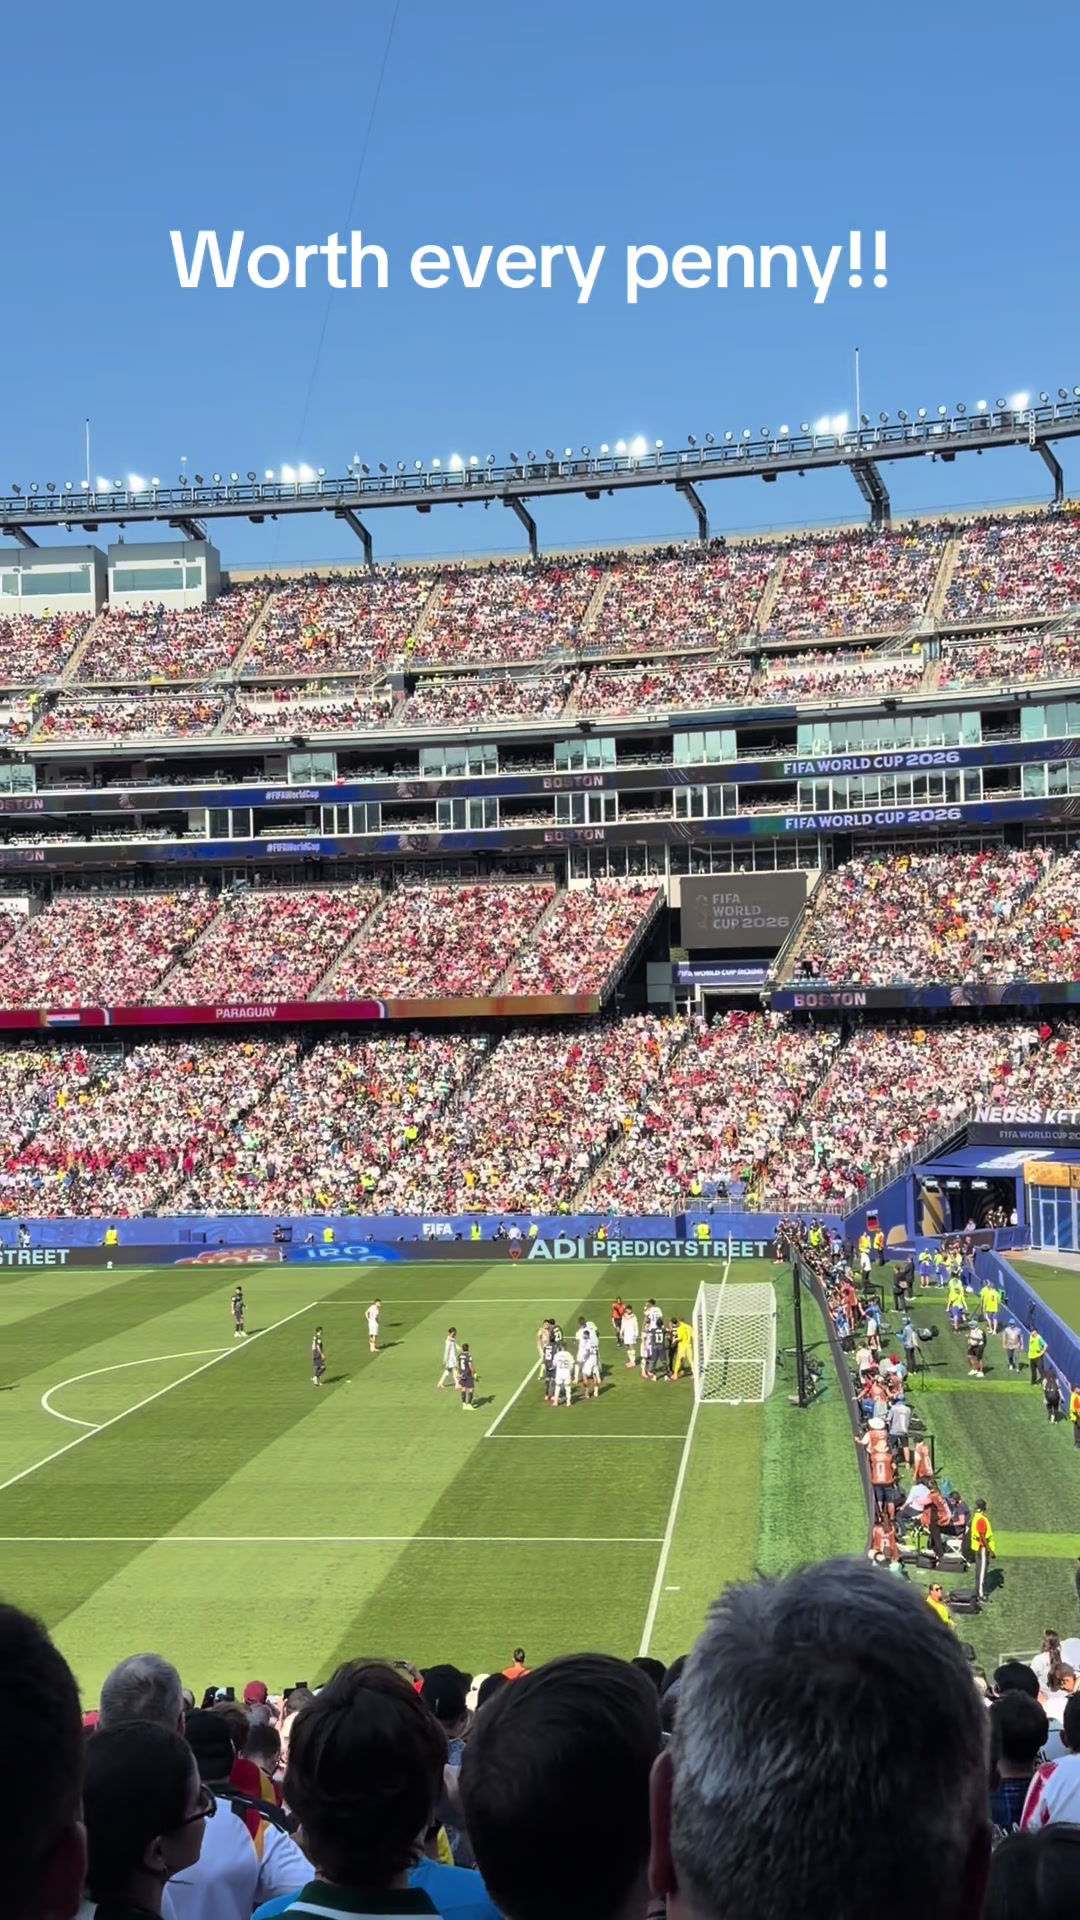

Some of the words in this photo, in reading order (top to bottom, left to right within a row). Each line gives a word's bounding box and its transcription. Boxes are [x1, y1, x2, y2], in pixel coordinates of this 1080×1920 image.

[783, 762, 816, 775] FIFA
[816, 756, 871, 772] WORLD
[873, 754, 904, 769] CUP
[906, 751, 960, 766] 2026
[543, 774, 604, 789] BOSTON
[265, 788, 320, 800] #FIFAWorldCup
[785, 818, 817, 830] FIFA
[818, 812, 872, 828] WORLD
[874, 810, 905, 824] CUP
[907, 808, 962, 822] 2026
[712, 894, 741, 904] FIFA
[712, 905, 762, 917] WORLD
[713, 918, 740, 929] CUP
[742, 917, 790, 928] 2026
[694, 969, 720, 977] WORLD
[721, 968, 737, 976] CUP
[793, 992, 867, 1007] BOSTON
[215, 1006, 278, 1019] PARAGUAY
[999, 1130, 1018, 1138] FIFA
[1019, 1131, 1052, 1139] WORLD
[1052, 1132, 1068, 1140] CUP
[422, 1223, 453, 1235] FIFA
[527, 1239, 585, 1260] ADI
[592, 1240, 768, 1258] PREDICTSTREET
